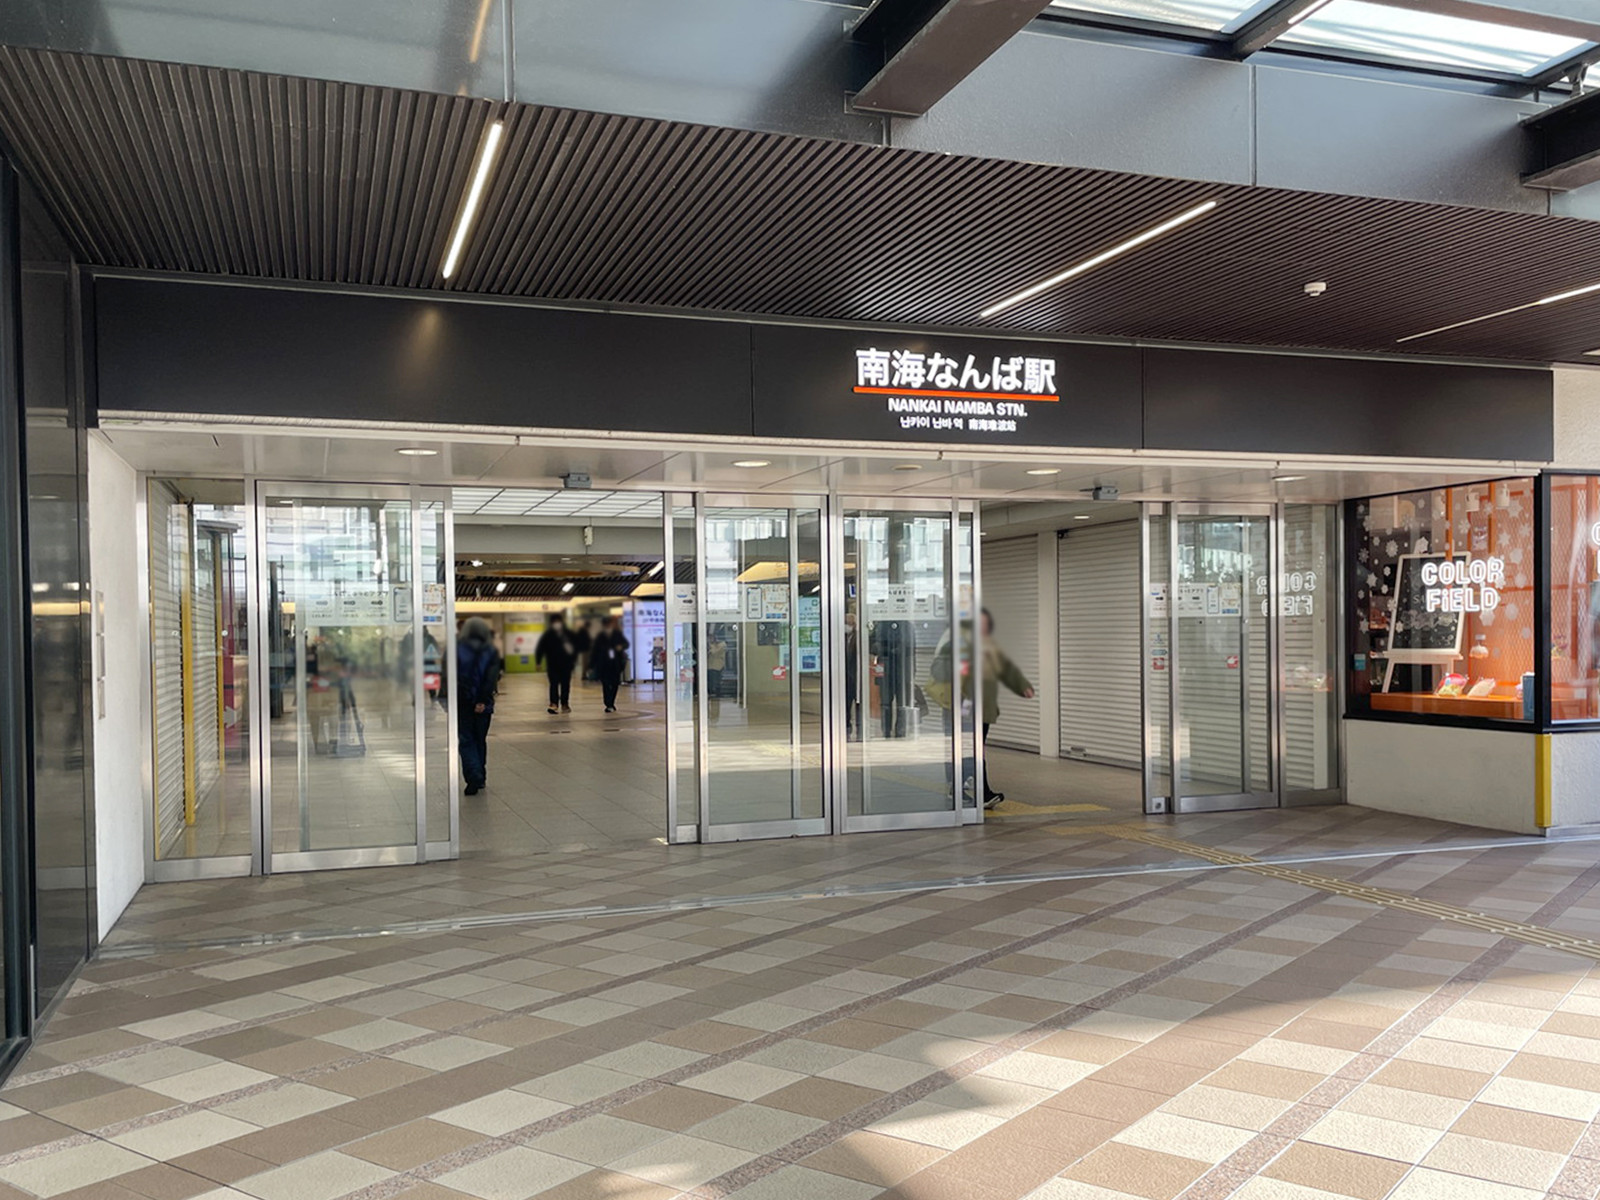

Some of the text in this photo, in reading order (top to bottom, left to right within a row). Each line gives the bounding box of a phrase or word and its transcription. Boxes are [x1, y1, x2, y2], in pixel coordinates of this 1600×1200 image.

[855, 347, 1057, 394] 南海なんば駅
[888, 398, 1028, 417] NANKAI NAMBA STN.
[1421, 558, 1504, 586] COLOR
